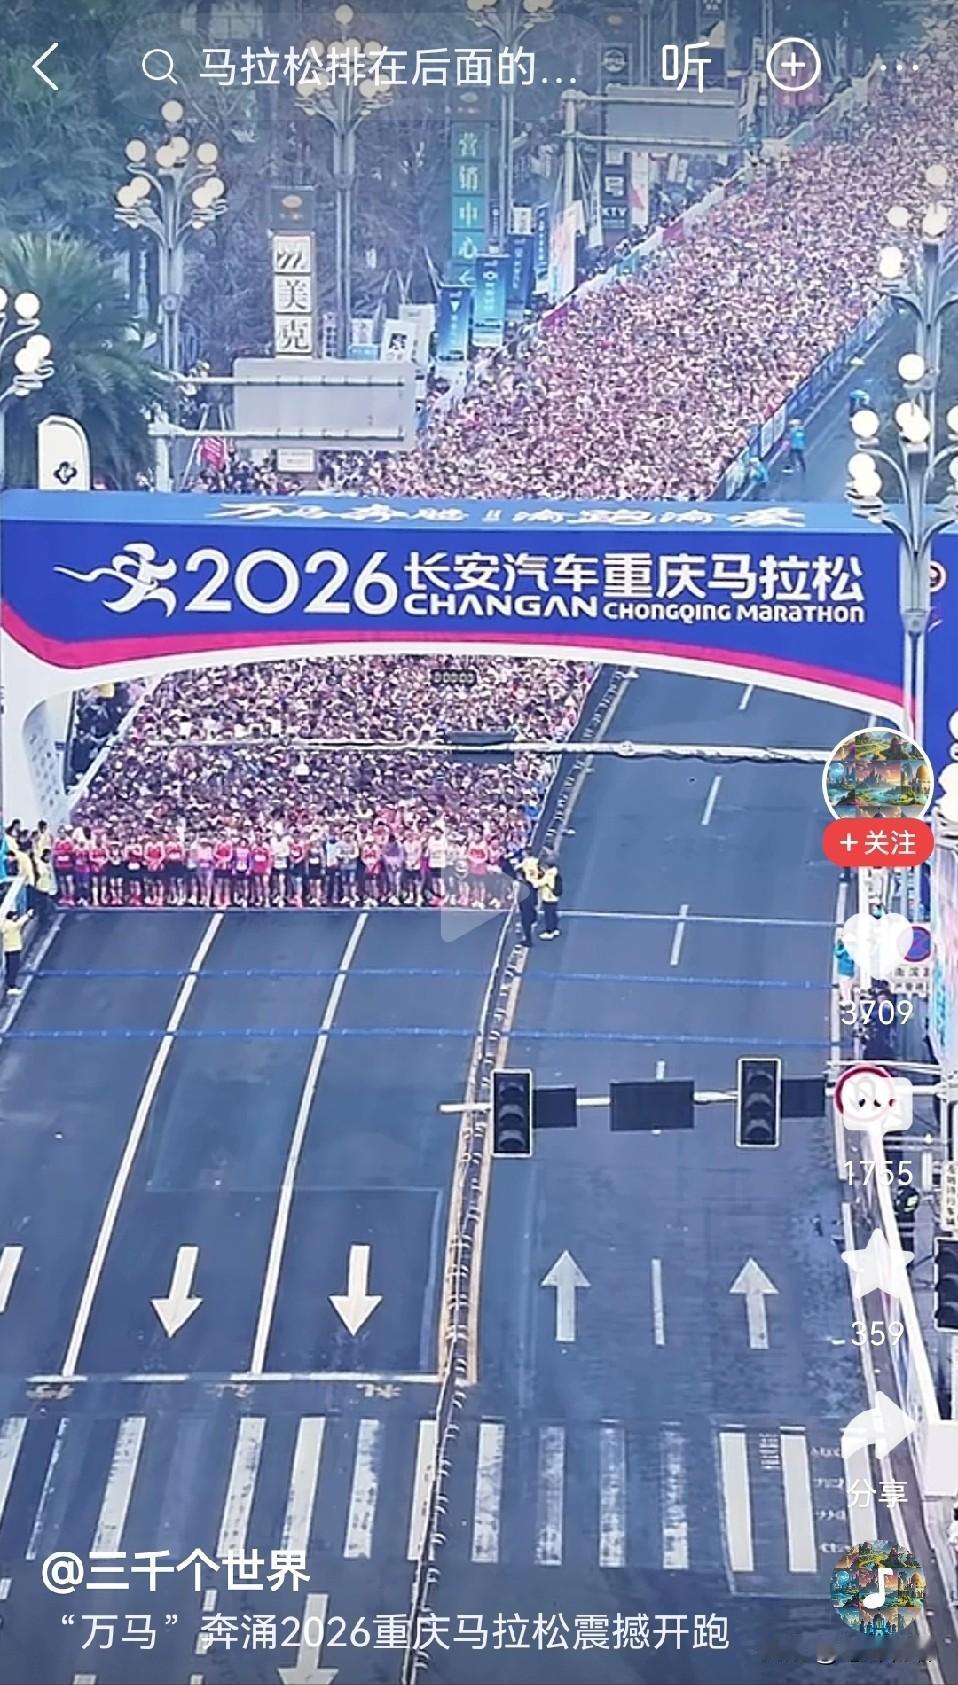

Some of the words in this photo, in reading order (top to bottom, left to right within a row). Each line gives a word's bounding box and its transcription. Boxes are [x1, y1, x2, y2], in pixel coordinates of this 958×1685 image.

[458, 130, 478, 260] 营销中心
[185, 549, 398, 615] 2026
[404, 551, 864, 602] 长安汽车重庆马拉松
[404, 593, 597, 617] CHANGAN
[603, 602, 731, 624] CHONGQING
[736, 600, 864, 624] MARATHON
